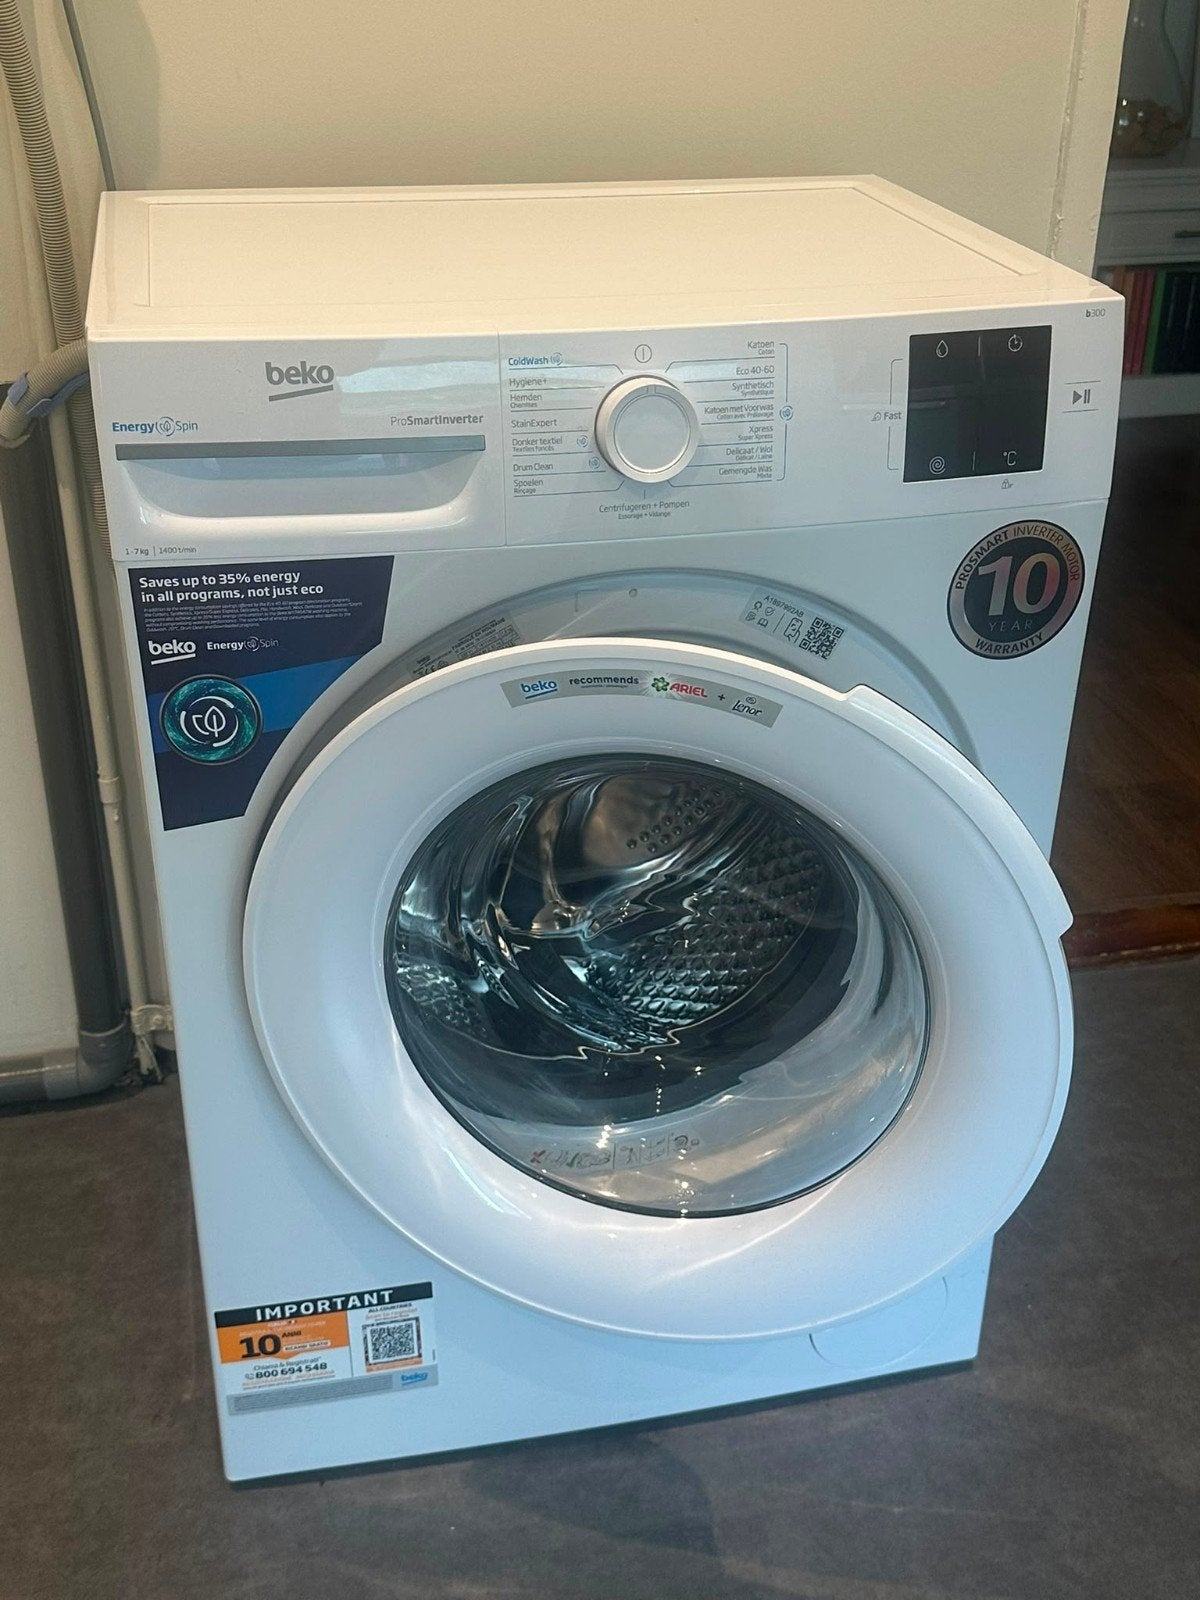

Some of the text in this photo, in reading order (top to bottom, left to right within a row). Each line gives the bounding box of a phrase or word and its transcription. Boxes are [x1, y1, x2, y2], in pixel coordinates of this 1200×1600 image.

[1086, 309, 1105, 318] b300
[748, 341, 774, 349] Katoen
[508, 356, 549, 366] ColdWash
[265, 361, 334, 385] beko
[736, 365, 775, 375] Eco 40-60
[732, 381, 774, 391] Synthetisch
[510, 394, 542, 402] Hemden
[744, 404, 774, 412] Voorwas
[390, 415, 484, 426] ProSmartInverter
[883, 411, 902, 421] Fast
[112, 421, 198, 434] Energy Spin
[511, 419, 557, 428] StainExpert
[749, 425, 774, 433] Xpress
[512, 436, 562, 446] Donker textiel
[726, 448, 755, 456] Delicaat
[760, 445, 773, 453] Wol
[513, 464, 533, 472] Drum
[719, 465, 772, 476] Gemengde Was
[513, 480, 543, 488] Spoelen
[599, 503, 652, 513] Centrifugeren
[659, 501, 690, 509] Pompen
[955, 525, 1080, 590] PROSMART INVERTER MOTOR
[139, 572, 300, 588] Saves up to 35% energy
[978, 552, 1061, 616] 10
[141, 585, 324, 602] in all programs, not just eco
[988, 619, 1033, 632] YEAR
[148, 639, 197, 655] beko
[206, 638, 279, 651] Energy Spin
[975, 632, 1044, 655] WARRANTY
[521, 679, 558, 693] beko
[569, 676, 640, 685] recommends
[669, 683, 708, 698] ARIEL
[732, 700, 763, 717] Lenor
[255, 1289, 394, 1321] IMPORTANT
[239, 1333, 282, 1358] 10
[255, 1369, 279, 1379] 800
[280, 1366, 303, 1375] 694
[305, 1362, 328, 1372] 548
